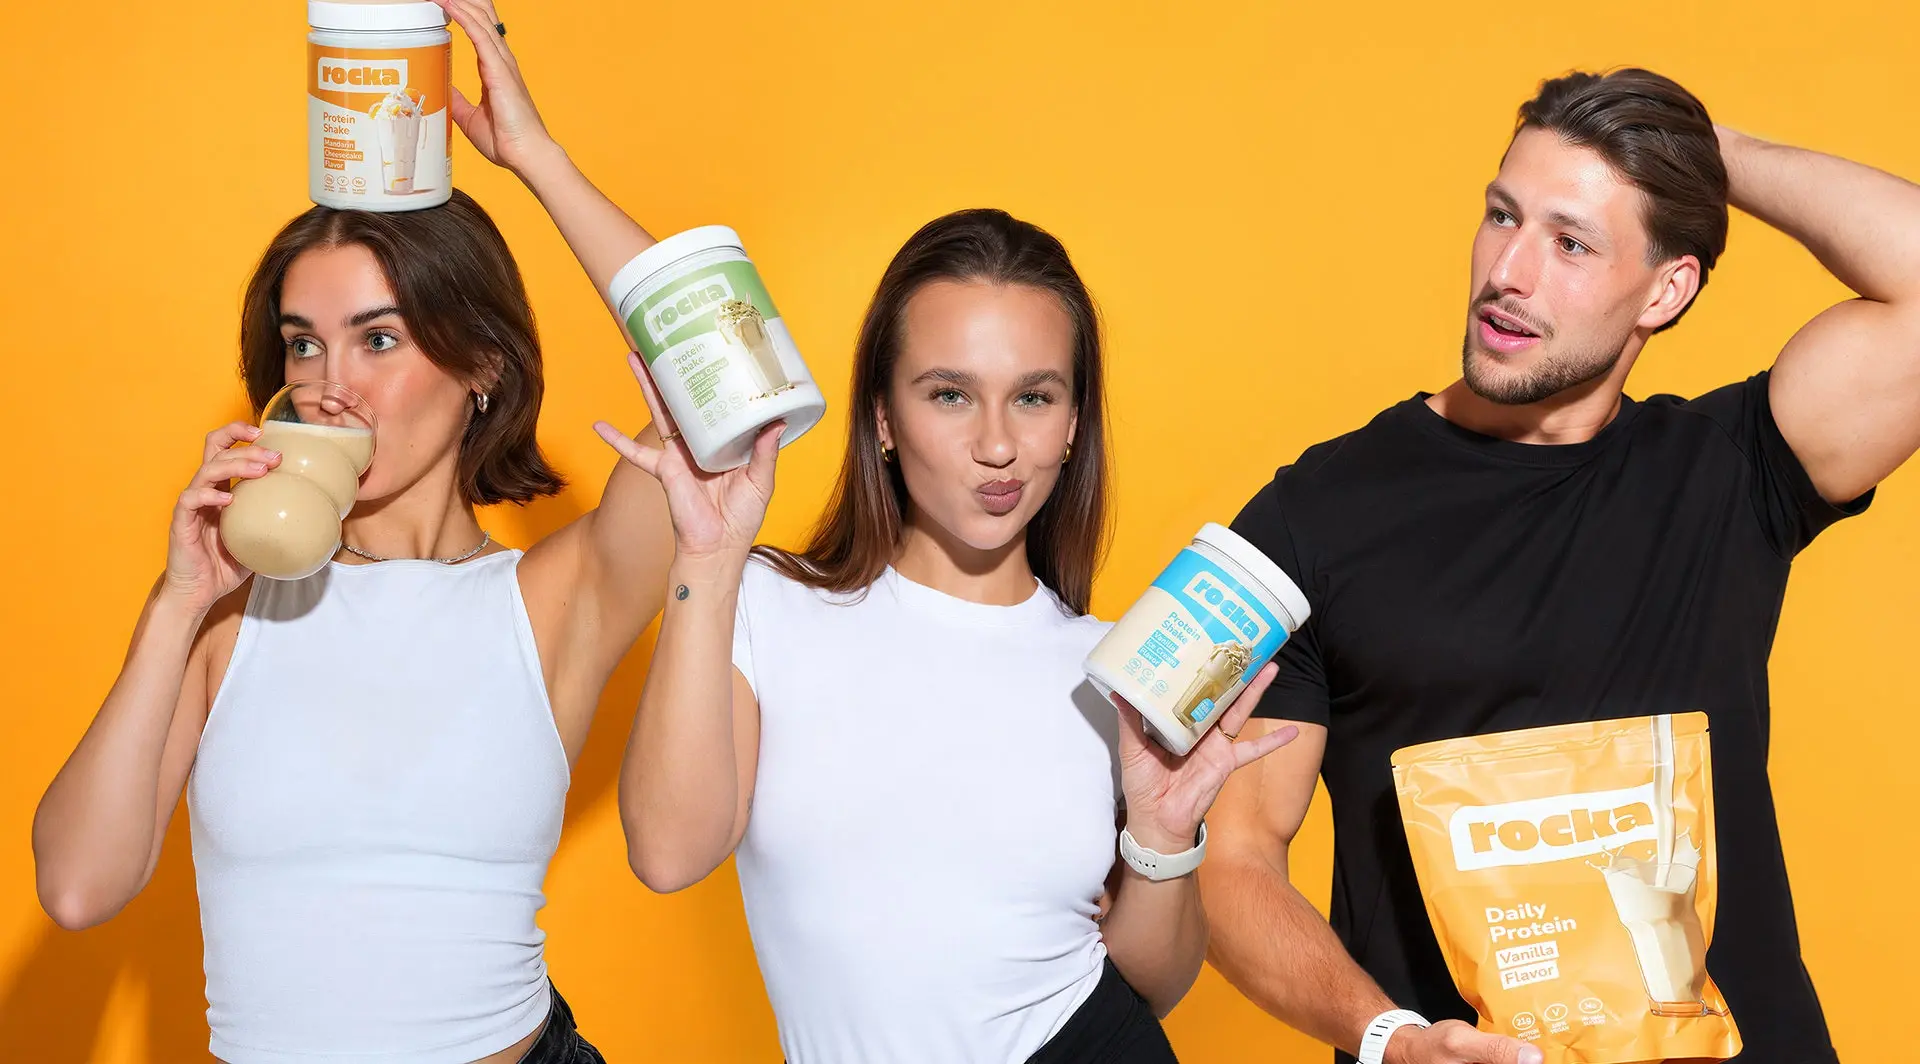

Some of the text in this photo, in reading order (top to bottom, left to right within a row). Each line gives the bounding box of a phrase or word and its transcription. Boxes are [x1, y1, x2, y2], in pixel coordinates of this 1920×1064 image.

[322, 65, 400, 86] rocka
[323, 112, 356, 124] Protein
[323, 123, 350, 135] Shake
[324, 138, 354, 148] Mandarin
[324, 149, 362, 159] Cheesecake
[325, 159, 343, 169] Flavor
[652, 284, 728, 334] rocka
[672, 343, 705, 368] Protein
[677, 356, 705, 378] Shake
[685, 372, 706, 390] White
[690, 374, 719, 398] Pistachio
[695, 391, 715, 408] Flavor
[1193, 578, 1260, 642] rocka
[1161, 620, 1188, 644] Shake
[1168, 611, 1201, 641] Protein
[1154, 631, 1177, 653] Vanilla
[1139, 647, 1160, 667] Flavor
[1147, 639, 1157, 650] Ice
[1156, 648, 1177, 668] Cream
[1468, 801, 1654, 854] rocka
[1485, 902, 1546, 923] Daily
[1489, 916, 1577, 943] Protein
[1499, 945, 1554, 964] Vanilla
[1504, 966, 1554, 985] Flavor
[1516, 1017, 1532, 1026] 21g
[1551, 1008, 1560, 1017] V
